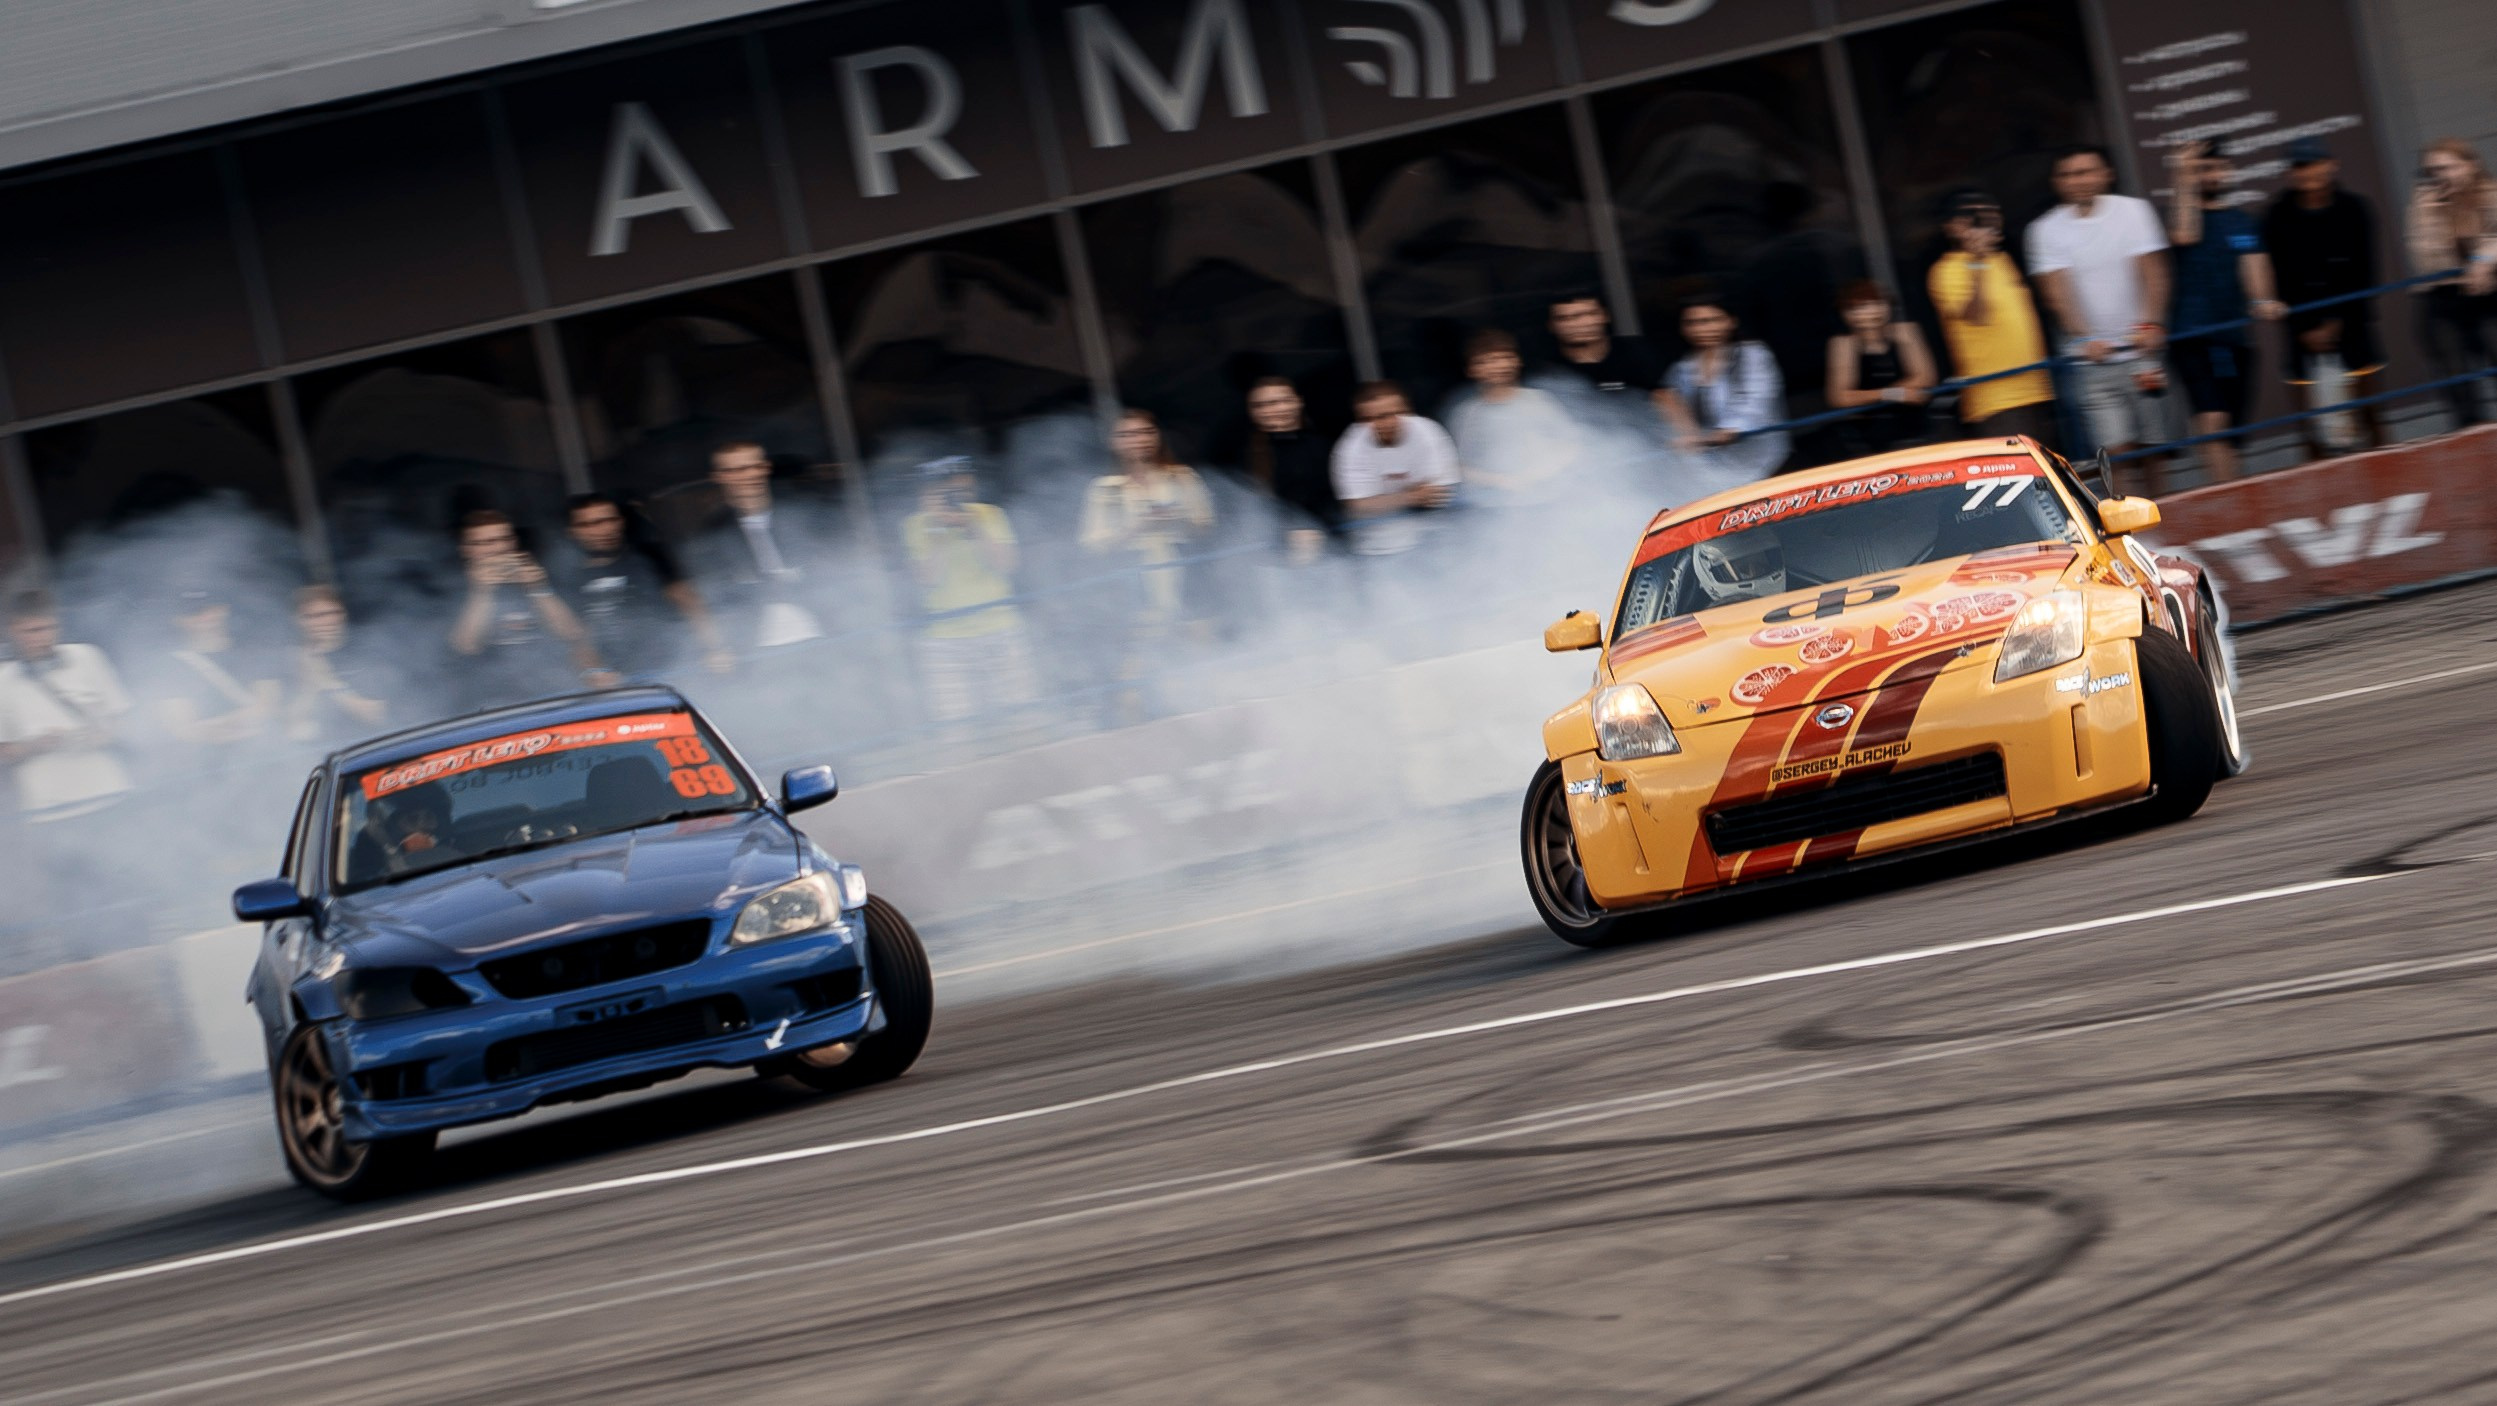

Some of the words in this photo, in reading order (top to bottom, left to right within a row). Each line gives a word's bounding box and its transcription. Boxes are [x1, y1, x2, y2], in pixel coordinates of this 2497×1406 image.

[1718, 489, 1819, 531] DRIFT
[1817, 473, 1900, 503] LETO
[1961, 475, 2035, 512] 77
[2187, 491, 2448, 583] TVZ
[2088, 671, 2131, 695] WORK
[376, 750, 472, 793] DRIFT
[470, 733, 552, 766] LETO
[656, 735, 711, 769] 18
[669, 763, 737, 799] 69
